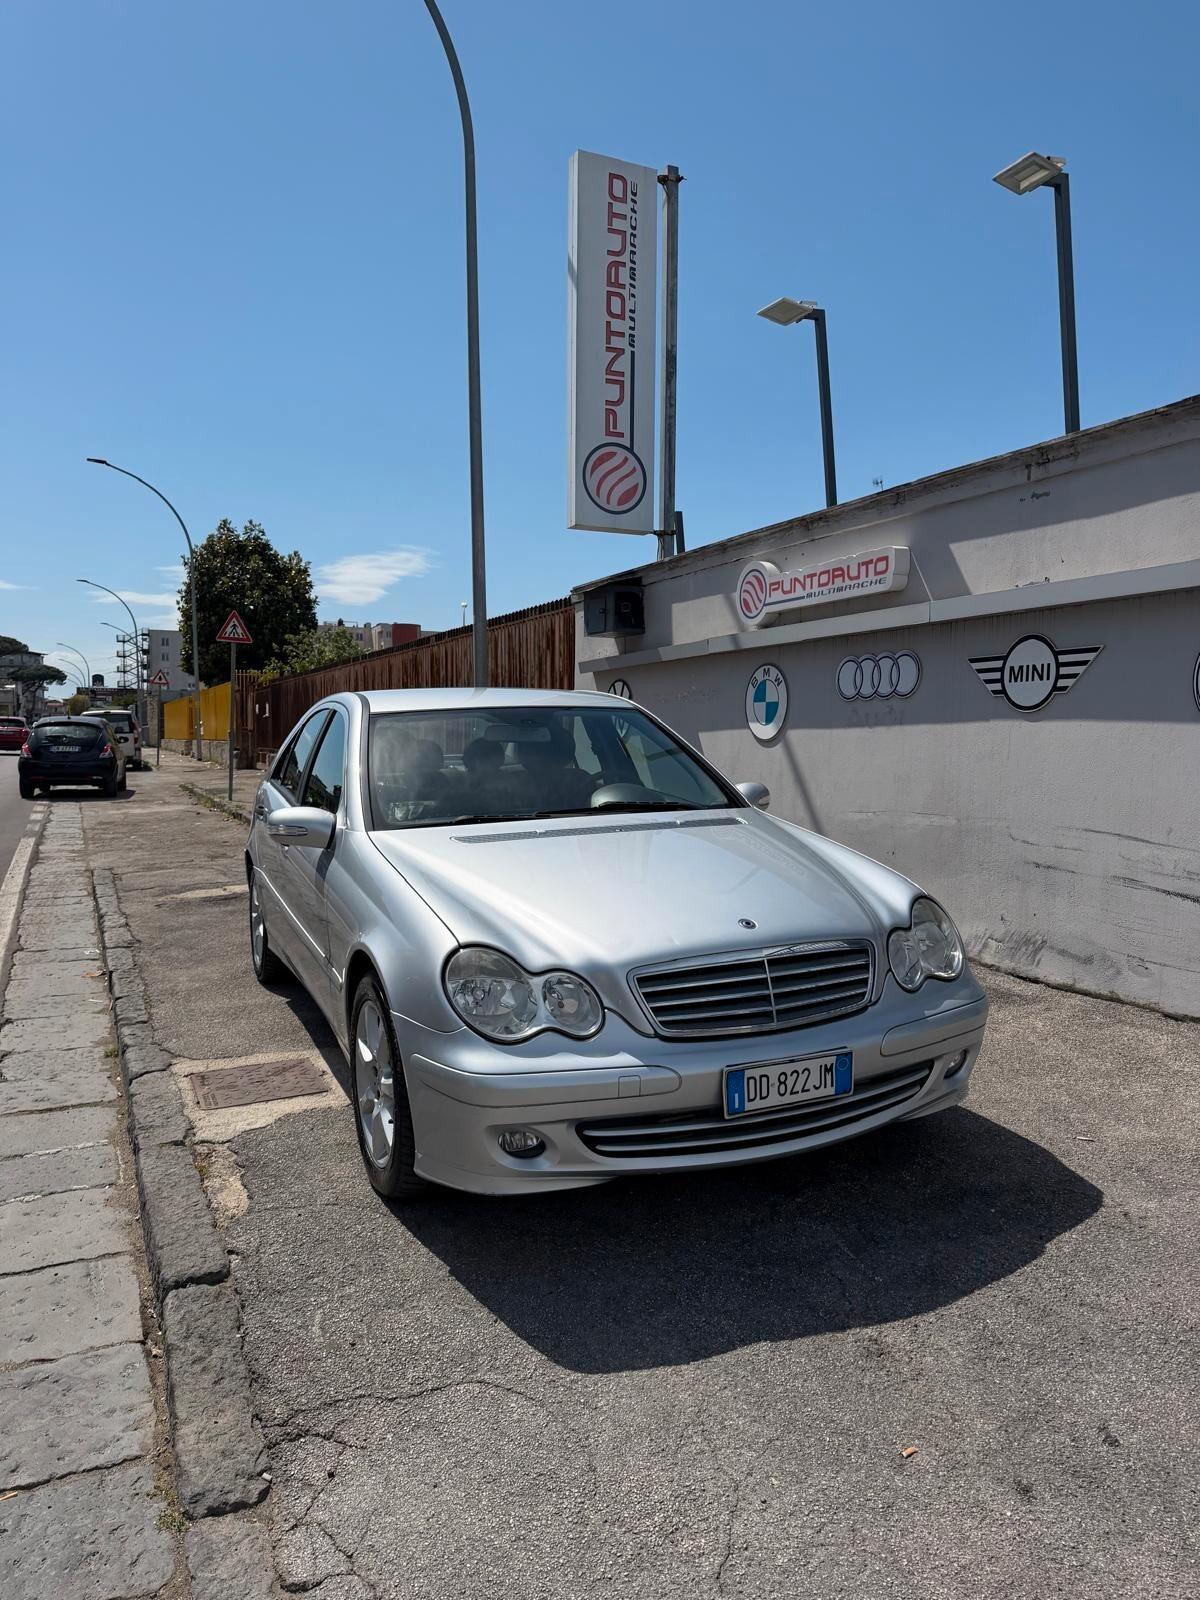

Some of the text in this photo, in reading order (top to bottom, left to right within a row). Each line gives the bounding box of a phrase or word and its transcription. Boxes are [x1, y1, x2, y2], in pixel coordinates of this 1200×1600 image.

[628, 181, 639, 349] MULTIMARCHE
[605, 172, 628, 438] PUNTOAUTO
[767, 555, 889, 598] PUNTOAUTO
[805, 577, 888, 599] MULTIMARCHE
[751, 667, 783, 689] BMW
[1009, 662, 1051, 683] MINI
[746, 1073, 770, 1103] DD
